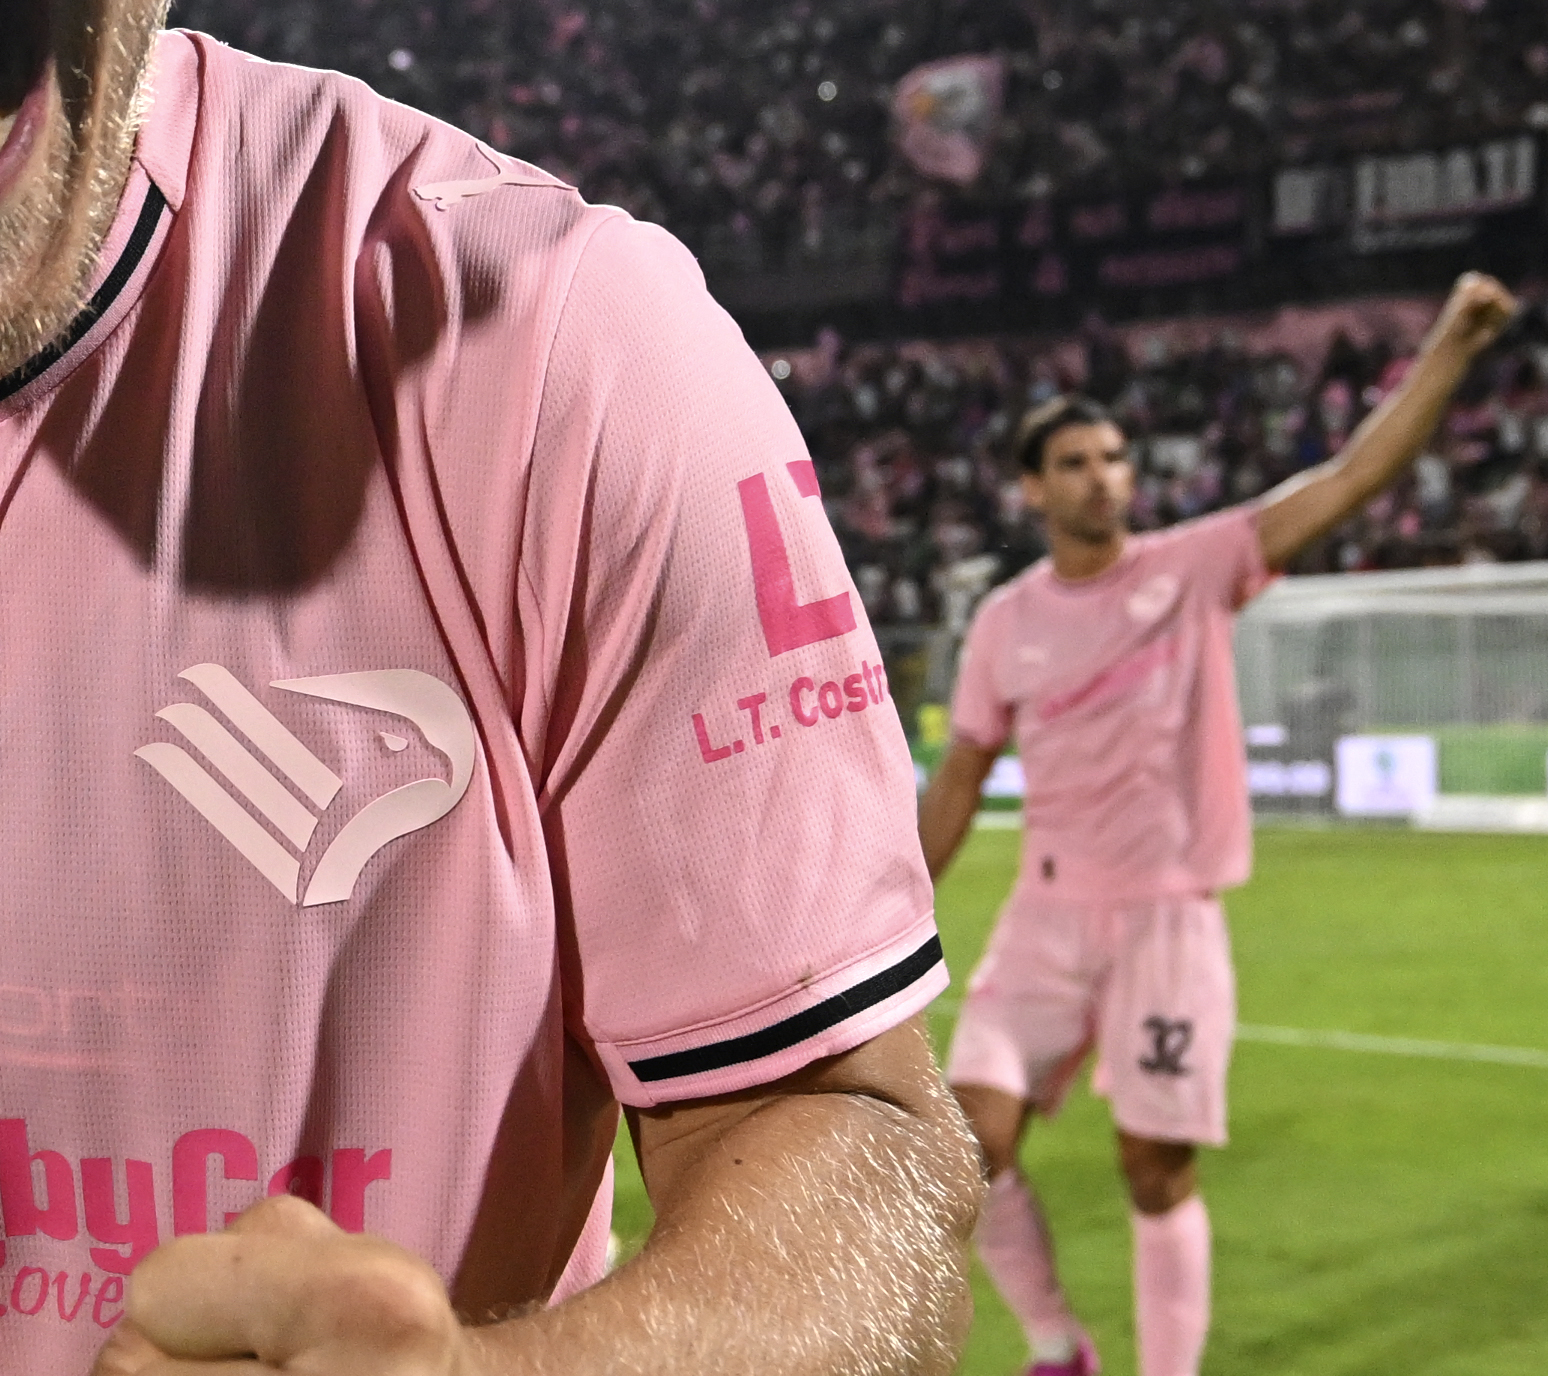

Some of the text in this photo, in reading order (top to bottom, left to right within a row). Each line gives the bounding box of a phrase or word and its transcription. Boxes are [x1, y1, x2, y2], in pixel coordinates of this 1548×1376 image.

[738, 460, 857, 657] L
[692, 692, 781, 763] L.T.
[1138, 1015, 1193, 1078] 32
